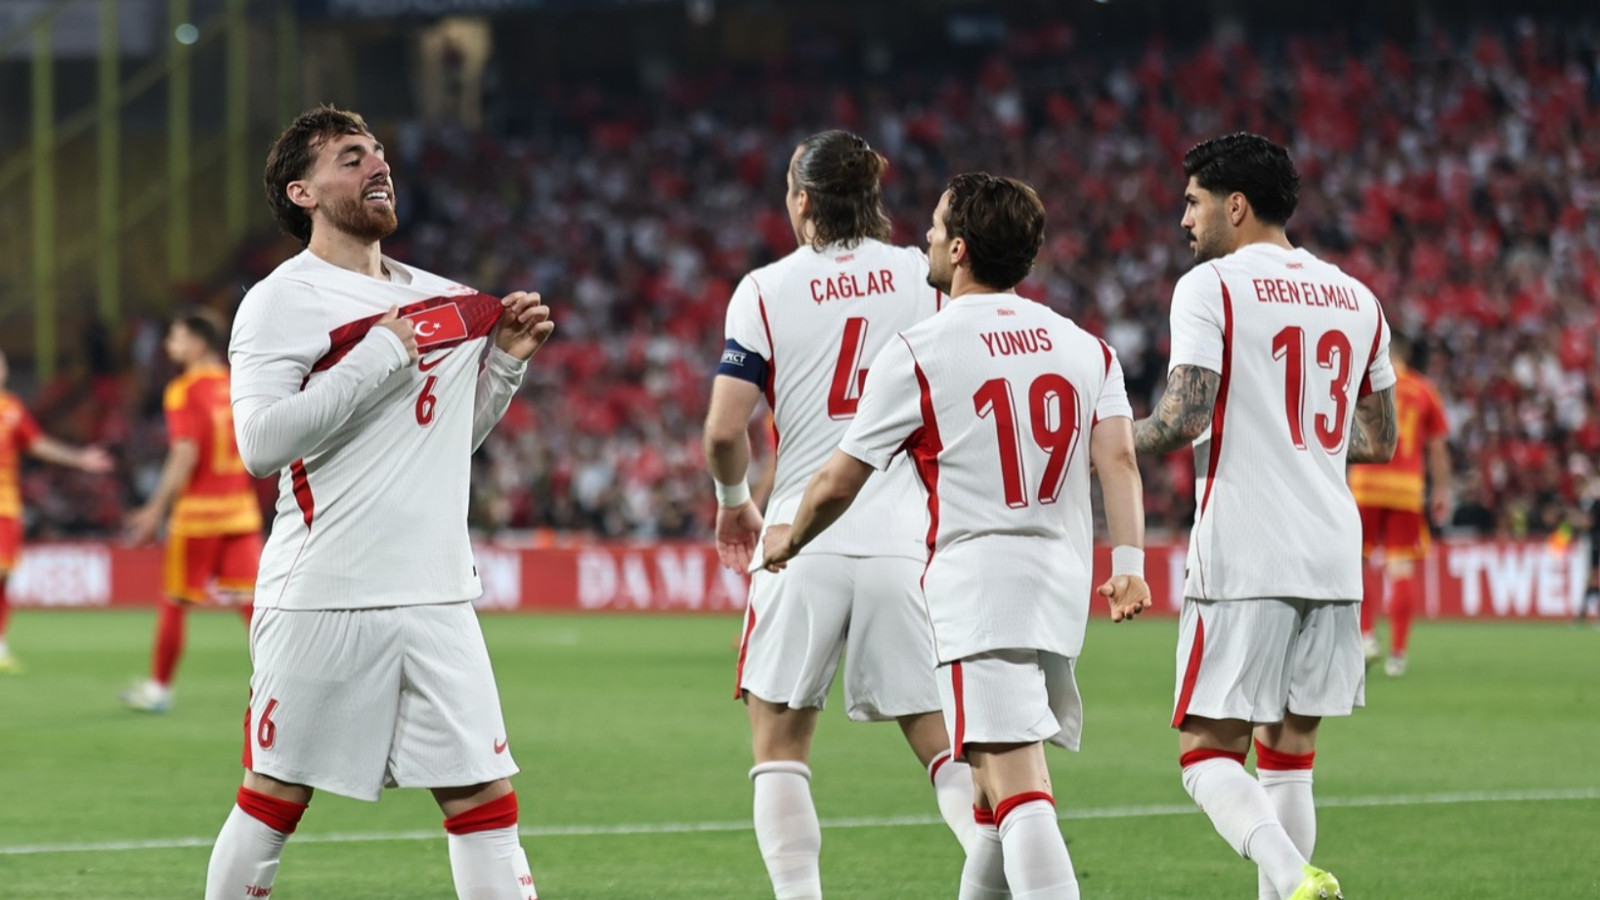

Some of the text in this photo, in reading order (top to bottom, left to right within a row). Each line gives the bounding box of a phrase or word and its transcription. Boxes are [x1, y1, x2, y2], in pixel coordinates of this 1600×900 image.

[810, 269, 896, 305] ÇAĞLAR
[1253, 279, 1360, 312] EREN ELMALI
[827, 317, 869, 421] 4
[980, 328, 1053, 357] YUNUS
[415, 375, 438, 428] 6
[1272, 326, 1354, 455] 13
[973, 373, 1081, 509] 19
[257, 698, 279, 751] 6
